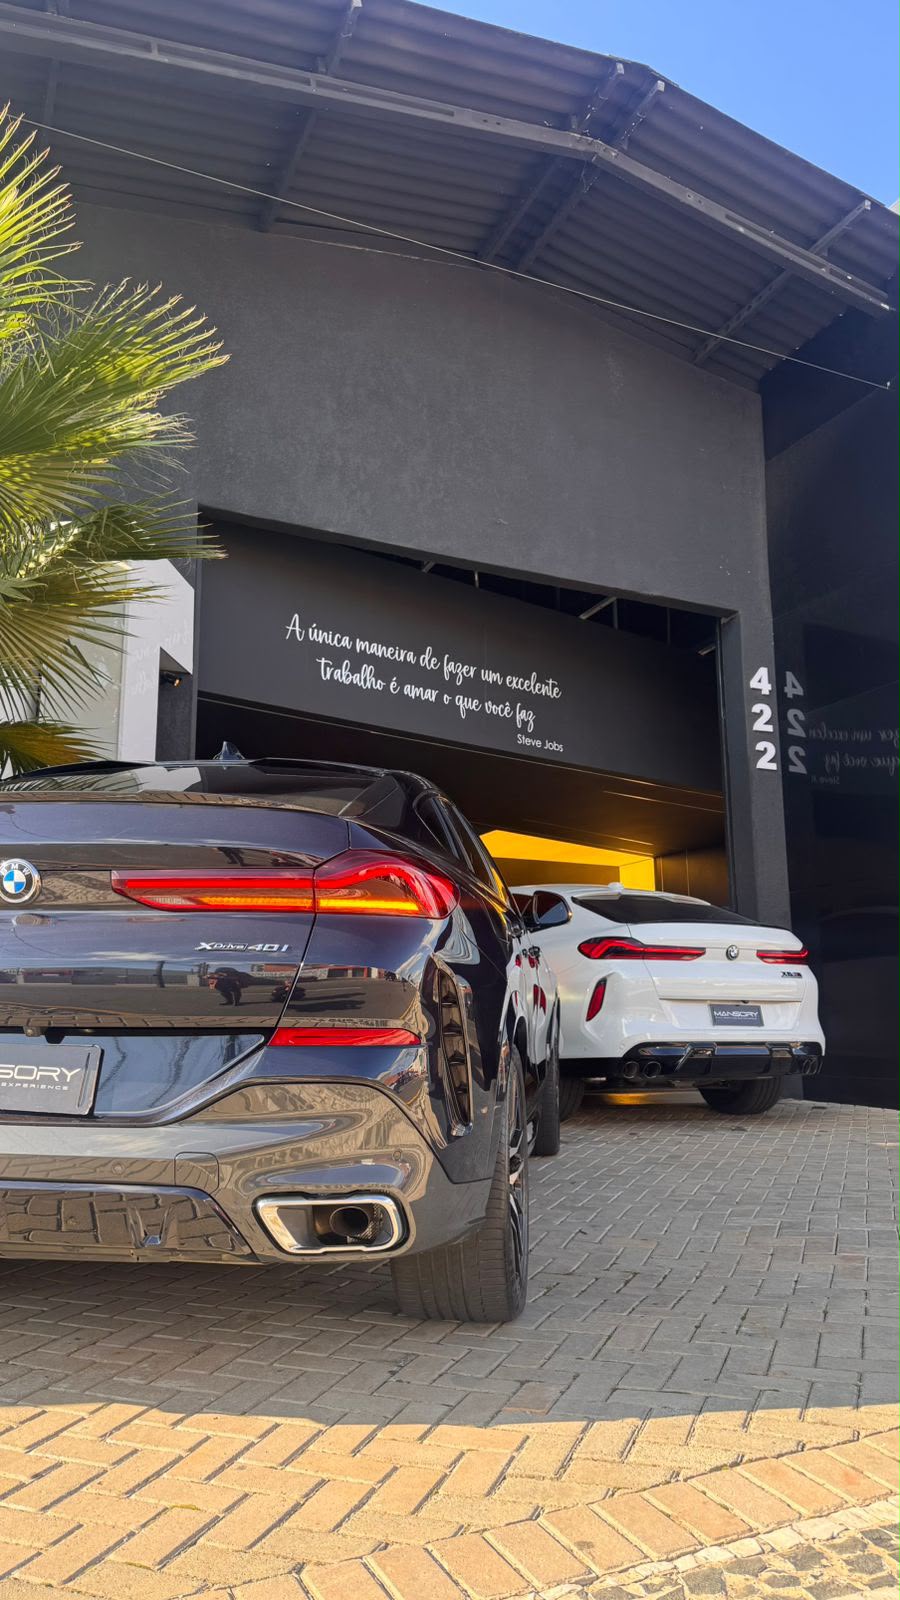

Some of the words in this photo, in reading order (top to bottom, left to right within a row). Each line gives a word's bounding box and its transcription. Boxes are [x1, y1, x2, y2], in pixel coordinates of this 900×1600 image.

[285, 613, 305, 641] A
[308, 623, 352, 649] única
[356, 638, 417, 664] maneira
[419, 646, 441, 670] de
[443, 654, 477, 686] fazer
[481, 669, 503, 685] um
[506, 672, 562, 699] excelente
[316, 657, 386, 691] trabalho
[389, 676, 401, 694] é
[404, 683, 439, 703] amar
[443, 692, 452, 705] o
[455, 694, 482, 719] que
[485, 701, 513, 719] você
[516, 703, 536, 732] faz
[516, 733, 542, 748] Steve
[543, 739, 564, 753] Jobs
[1, 1081, 69, 1091] EXPERIENCE
